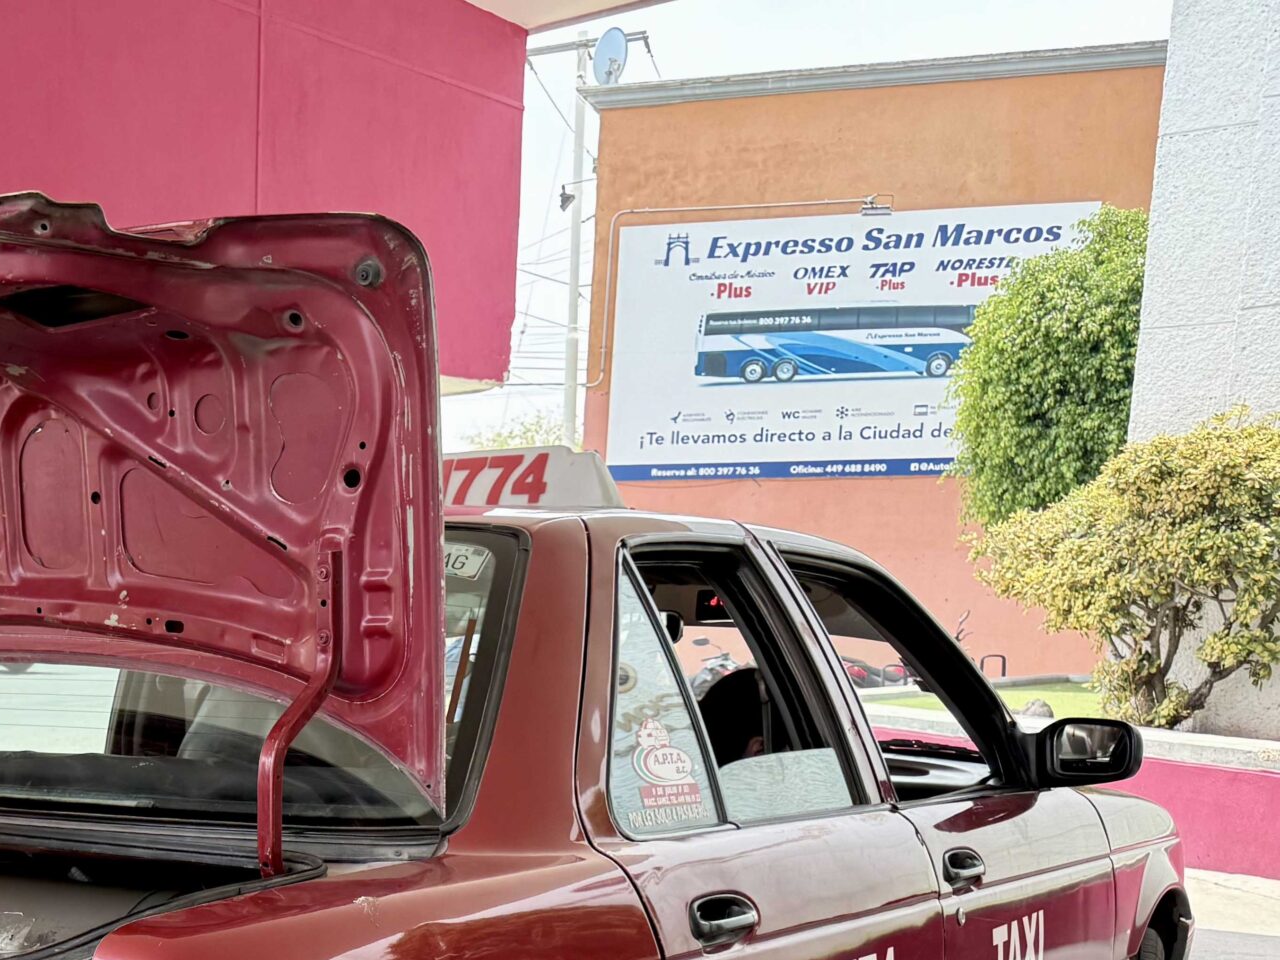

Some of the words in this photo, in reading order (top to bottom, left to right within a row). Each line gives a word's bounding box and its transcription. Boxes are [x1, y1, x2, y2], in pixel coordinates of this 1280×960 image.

[707, 236, 854, 262] Expresso
[861, 227, 925, 251] San
[932, 223, 1062, 247] Marcos
[793, 265, 850, 280] OMEX
[869, 261, 915, 279] TAP
[806, 281, 836, 295] VIP
[759, 317, 773, 325] 800
[782, 410, 801, 420] WC
[640, 431, 664, 449] ¡Te
[671, 431, 746, 445] llevamos
[753, 427, 816, 443] directo
[822, 431, 832, 441] a
[838, 425, 853, 441] la
[860, 422, 923, 440] Ciudad
[651, 467, 685, 477] Reserva
[698, 467, 715, 476] 800
[717, 466, 734, 476] 397
[735, 466, 746, 475] 76
[748, 466, 760, 475] 36
[790, 464, 823, 474] Oficina:
[825, 464, 842, 473] 449
[844, 463, 861, 473] 688
[863, 463, 887, 472] 8490
